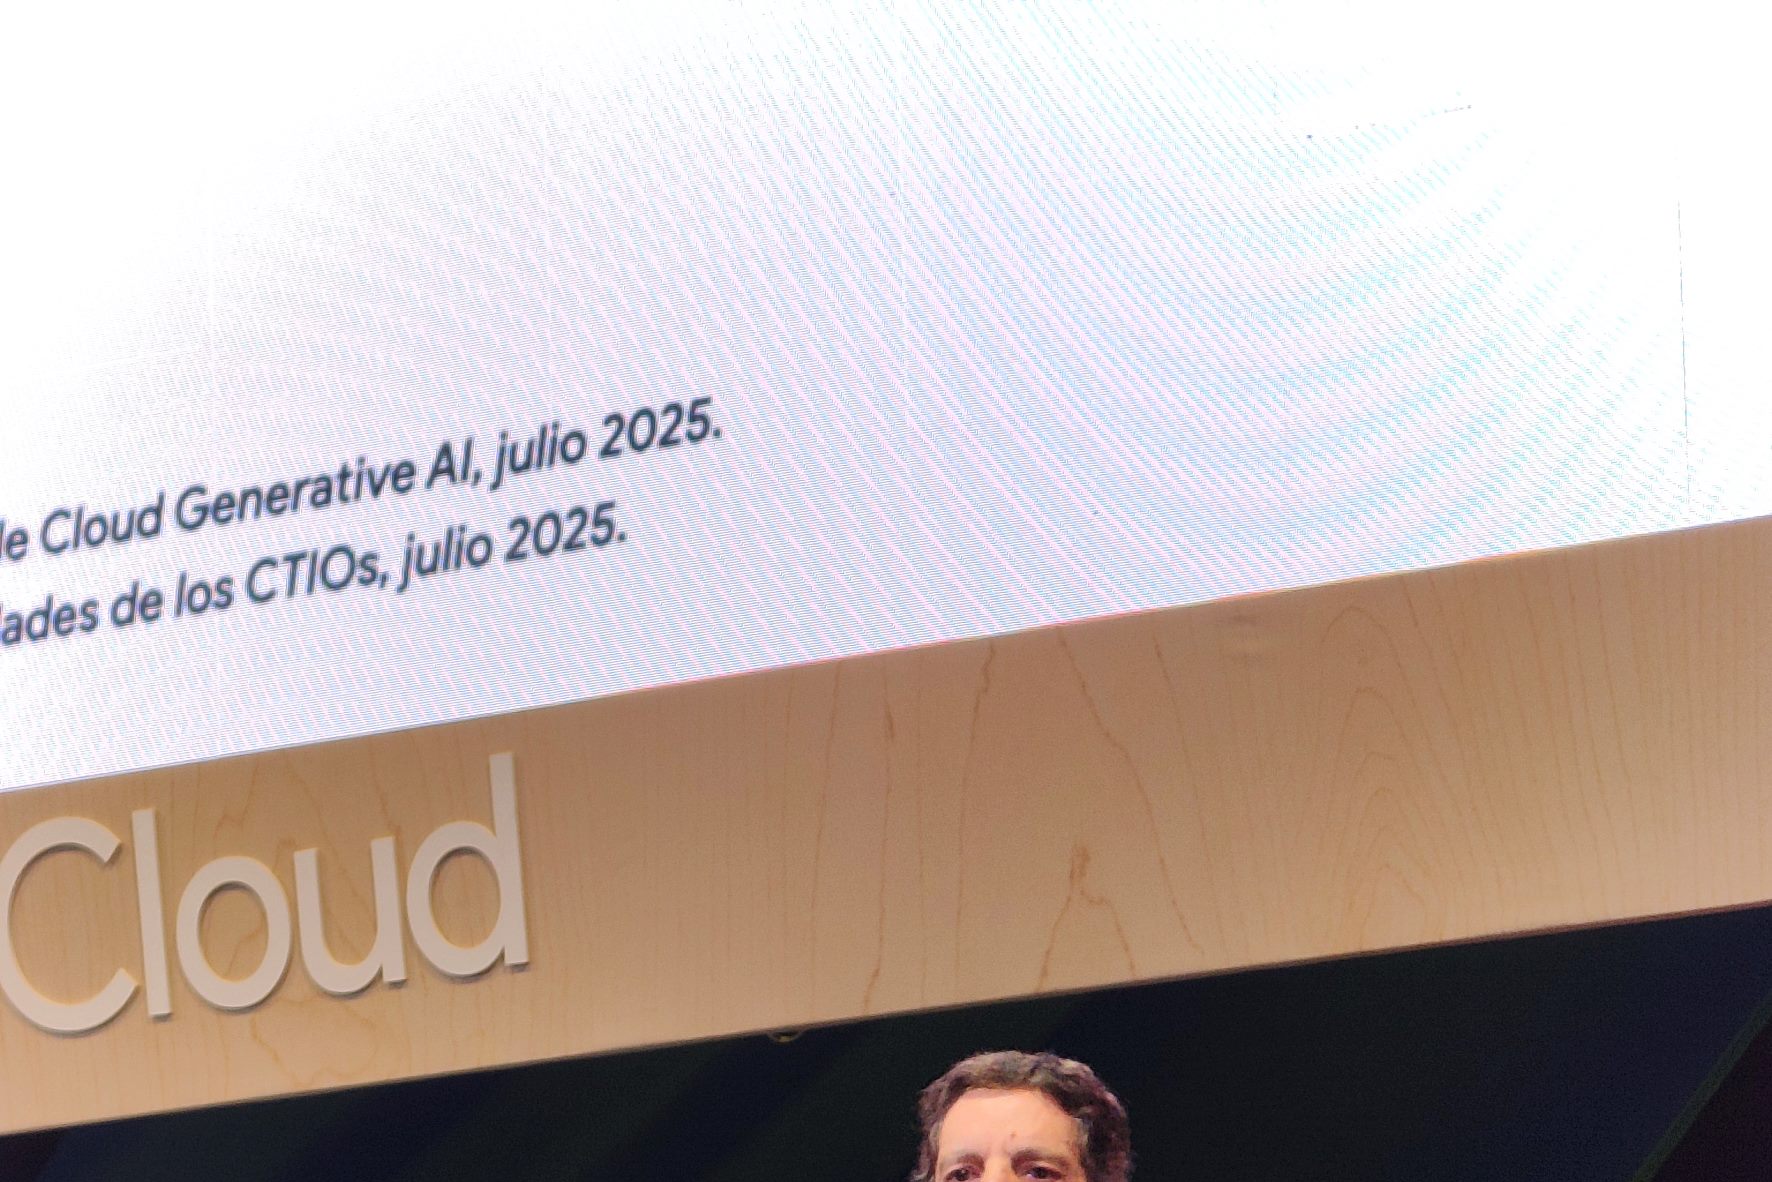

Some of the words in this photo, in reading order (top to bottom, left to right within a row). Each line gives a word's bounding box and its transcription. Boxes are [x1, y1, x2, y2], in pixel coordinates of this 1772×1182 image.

[41, 490, 165, 553] Cloud
[175, 457, 416, 531] Generative
[426, 438, 483, 488] AI,
[490, 420, 587, 492] julio
[600, 397, 722, 459] 2025.
[0, 593, 98, 645] ades
[111, 580, 163, 628] de
[175, 571, 234, 617] los
[246, 545, 390, 601] CTIOs,
[398, 525, 493, 593] julio
[504, 501, 627, 562] 2025.
[0, 752, 531, 1035] Cloud
